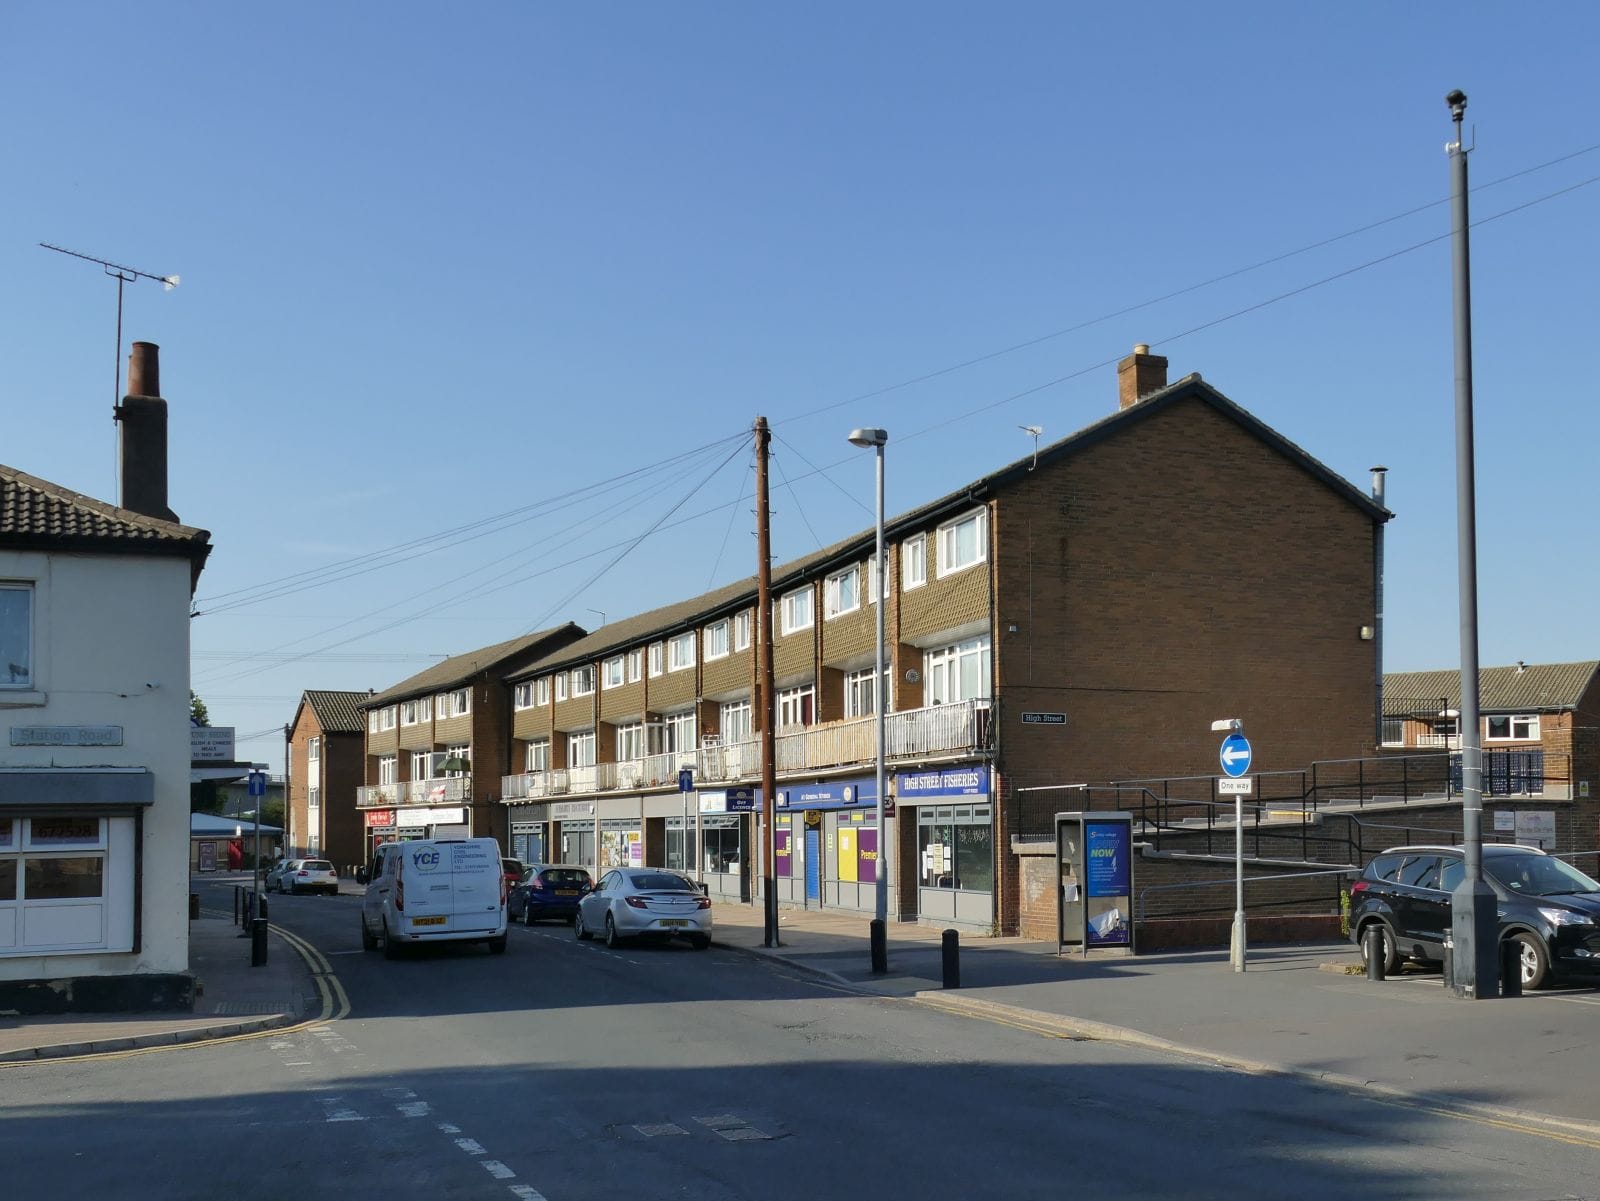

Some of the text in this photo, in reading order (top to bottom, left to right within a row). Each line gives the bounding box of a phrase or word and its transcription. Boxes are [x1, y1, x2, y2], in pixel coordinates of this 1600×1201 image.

[1025, 714, 1062, 722] High Street
[22, 729, 112, 741] Station Road
[904, 772, 979, 790] HIGH STREET FISHERIES
[1221, 782, 1249, 791] One way
[1091, 848, 1115, 858] NOW
[413, 853, 440, 865] YCE
